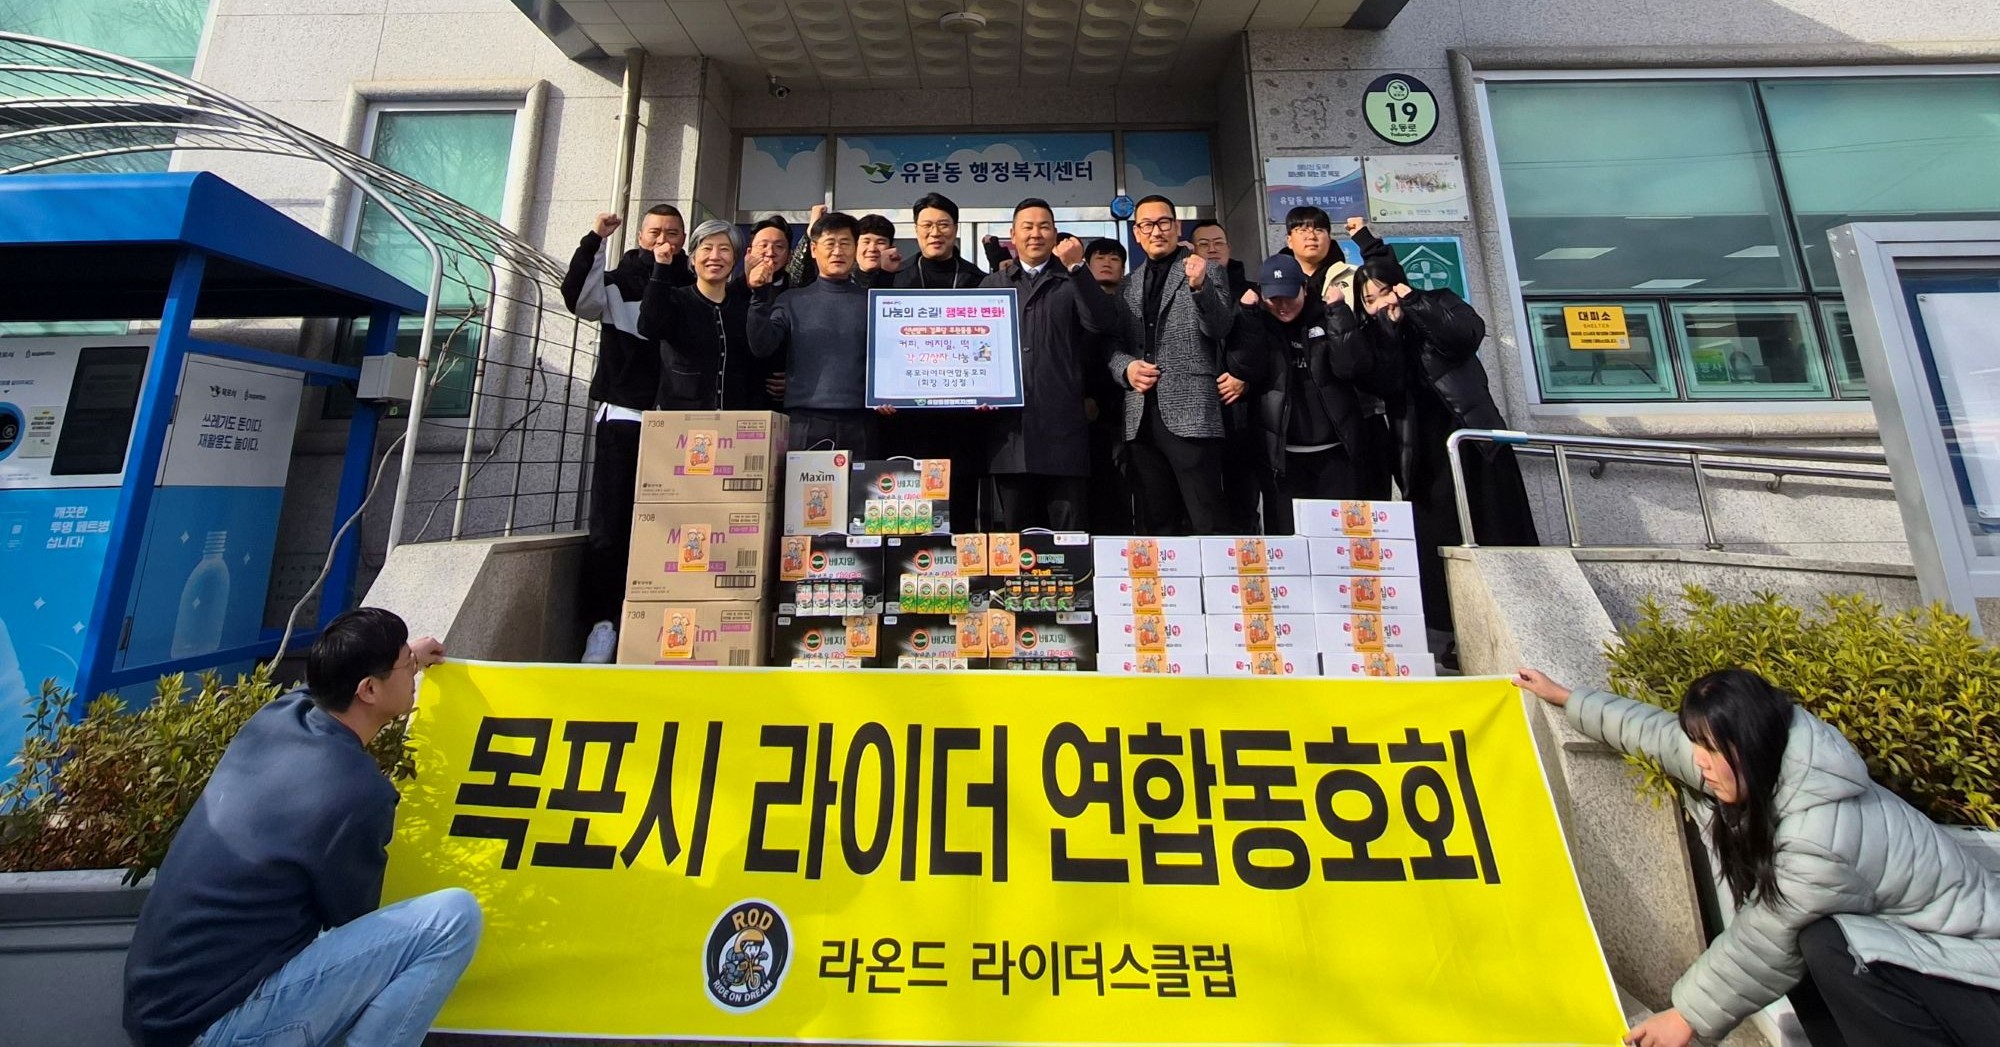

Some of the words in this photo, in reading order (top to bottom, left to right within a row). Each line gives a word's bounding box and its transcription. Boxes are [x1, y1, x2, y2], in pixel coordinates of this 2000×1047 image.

[1385, 102, 1418, 122] 19
[1390, 124, 1416, 132] 유동로
[901, 162, 962, 183] 유달동
[969, 161, 1093, 183] 행정복지센터
[882, 307, 914, 318] 나눔의
[918, 307, 942, 318] 손길!
[945, 307, 977, 318] 행복한
[980, 307, 1005, 318] 변화!
[1578, 311, 1611, 321] 대피소
[961, 340, 969, 349] 떡
[952, 353, 969, 363] 나눔
[201, 413, 236, 430] 쓰레기도
[237, 417, 262, 432] 돈이다.
[648, 420, 664, 428] 7308
[198, 434, 232, 449] 재활용도
[799, 470, 835, 482] Maxim
[54, 506, 88, 518] 깨끗한
[50, 521, 73, 533] 투명
[76, 520, 111, 533] 페트병
[828, 557, 856, 566] 베지밀
[627, 611, 645, 619] 7308
[1039, 634, 1066, 643] 베지밀
[449, 716, 723, 876] 목포시
[744, 721, 1008, 883] 라이더
[1041, 721, 1501, 890] 연합동호회
[819, 937, 948, 995] 라온드
[971, 940, 1236, 998] 라이더스클럽
[713, 979, 729, 998] RIDE
[729, 992, 742, 1002] ON
[744, 980, 773, 1001] DREAM
